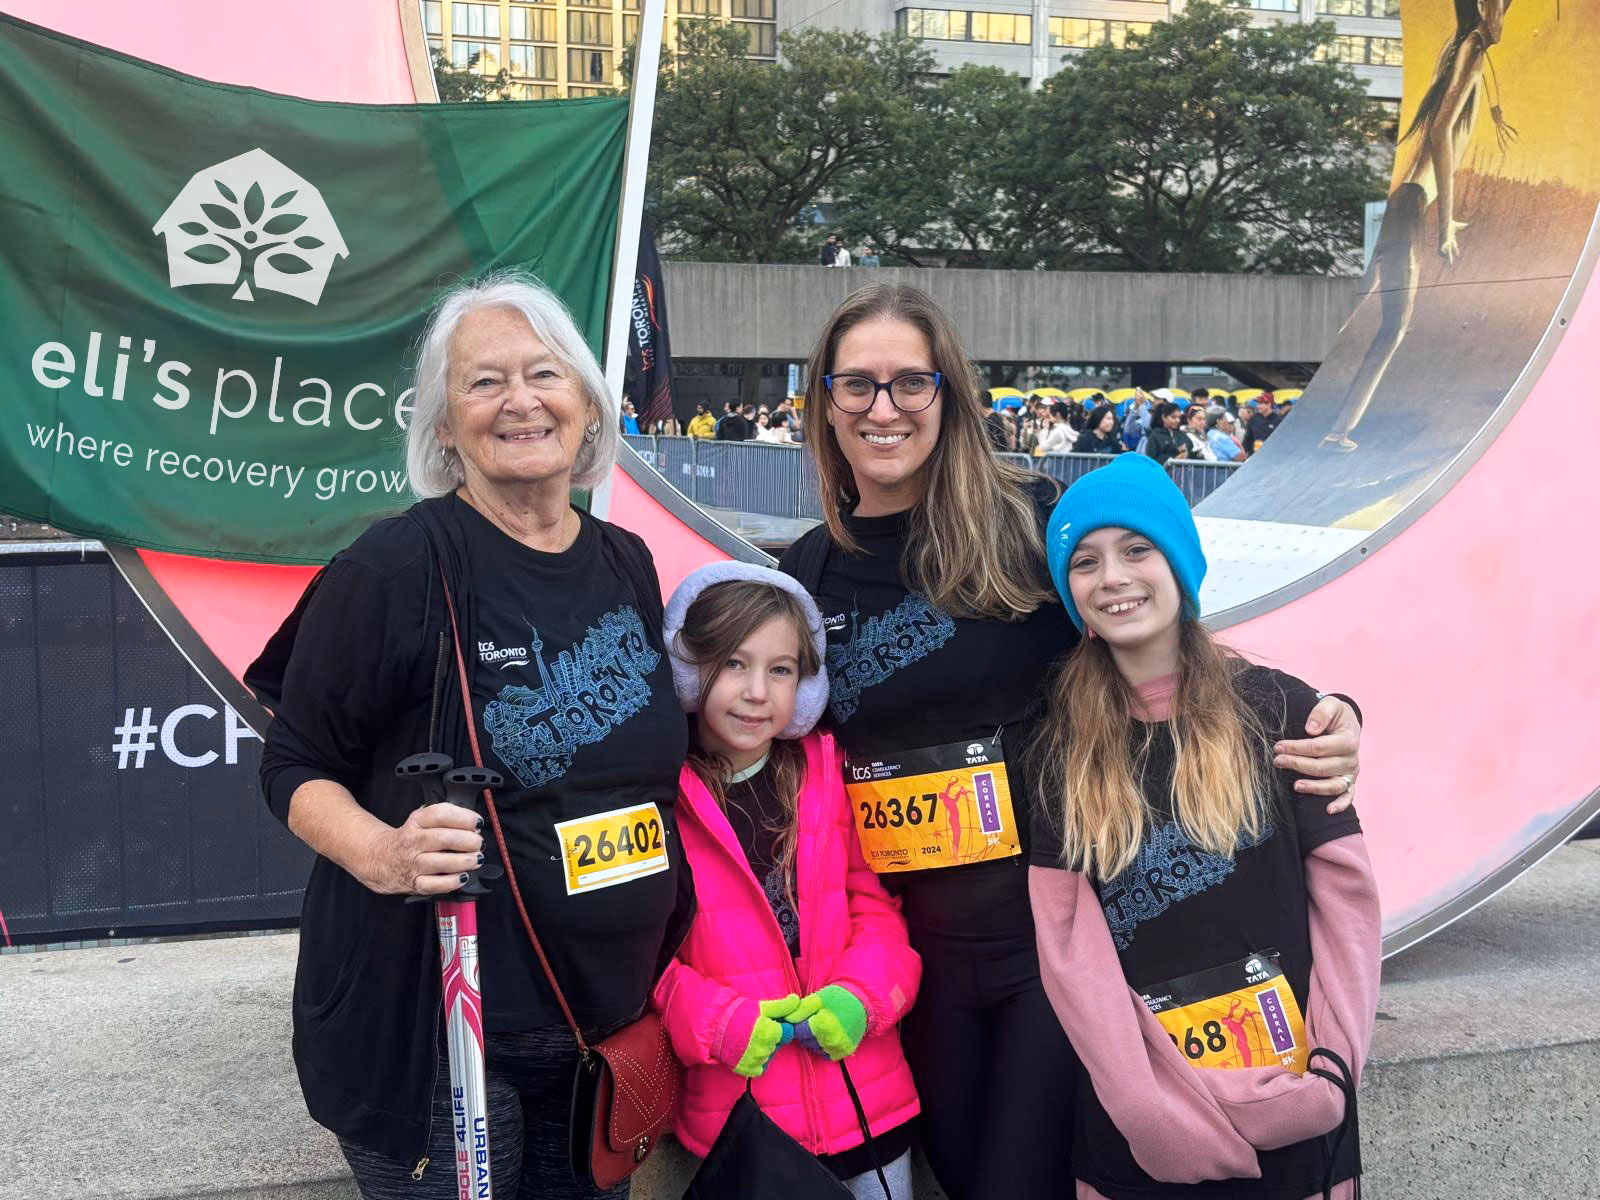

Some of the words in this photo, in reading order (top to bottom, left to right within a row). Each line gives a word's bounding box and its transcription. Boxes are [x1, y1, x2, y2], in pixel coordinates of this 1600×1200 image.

[31, 331, 191, 410] eli's
[27, 422, 133, 466] where
[145, 447, 305, 499] recovery
[823, 613, 846, 625] ONTO
[478, 641, 495, 652] tcs
[479, 647, 527, 662] TORONTO
[852, 765, 872, 780] tcs
[965, 755, 988, 765] TATA
[860, 793, 938, 829] 26367
[981, 779, 993, 824] CORRAL
[574, 818, 662, 868] 26402
[921, 845, 942, 854] 2024
[987, 836, 1000, 846] 5K
[1245, 970, 1270, 984] TATA
[1266, 997, 1285, 1042] CORRAL
[1169, 1020, 1227, 1060] 68
[1281, 1055, 1296, 1065] 5K
[453, 1086, 467, 1143] 4LIFE
[473, 1116, 489, 1198] URBAN
